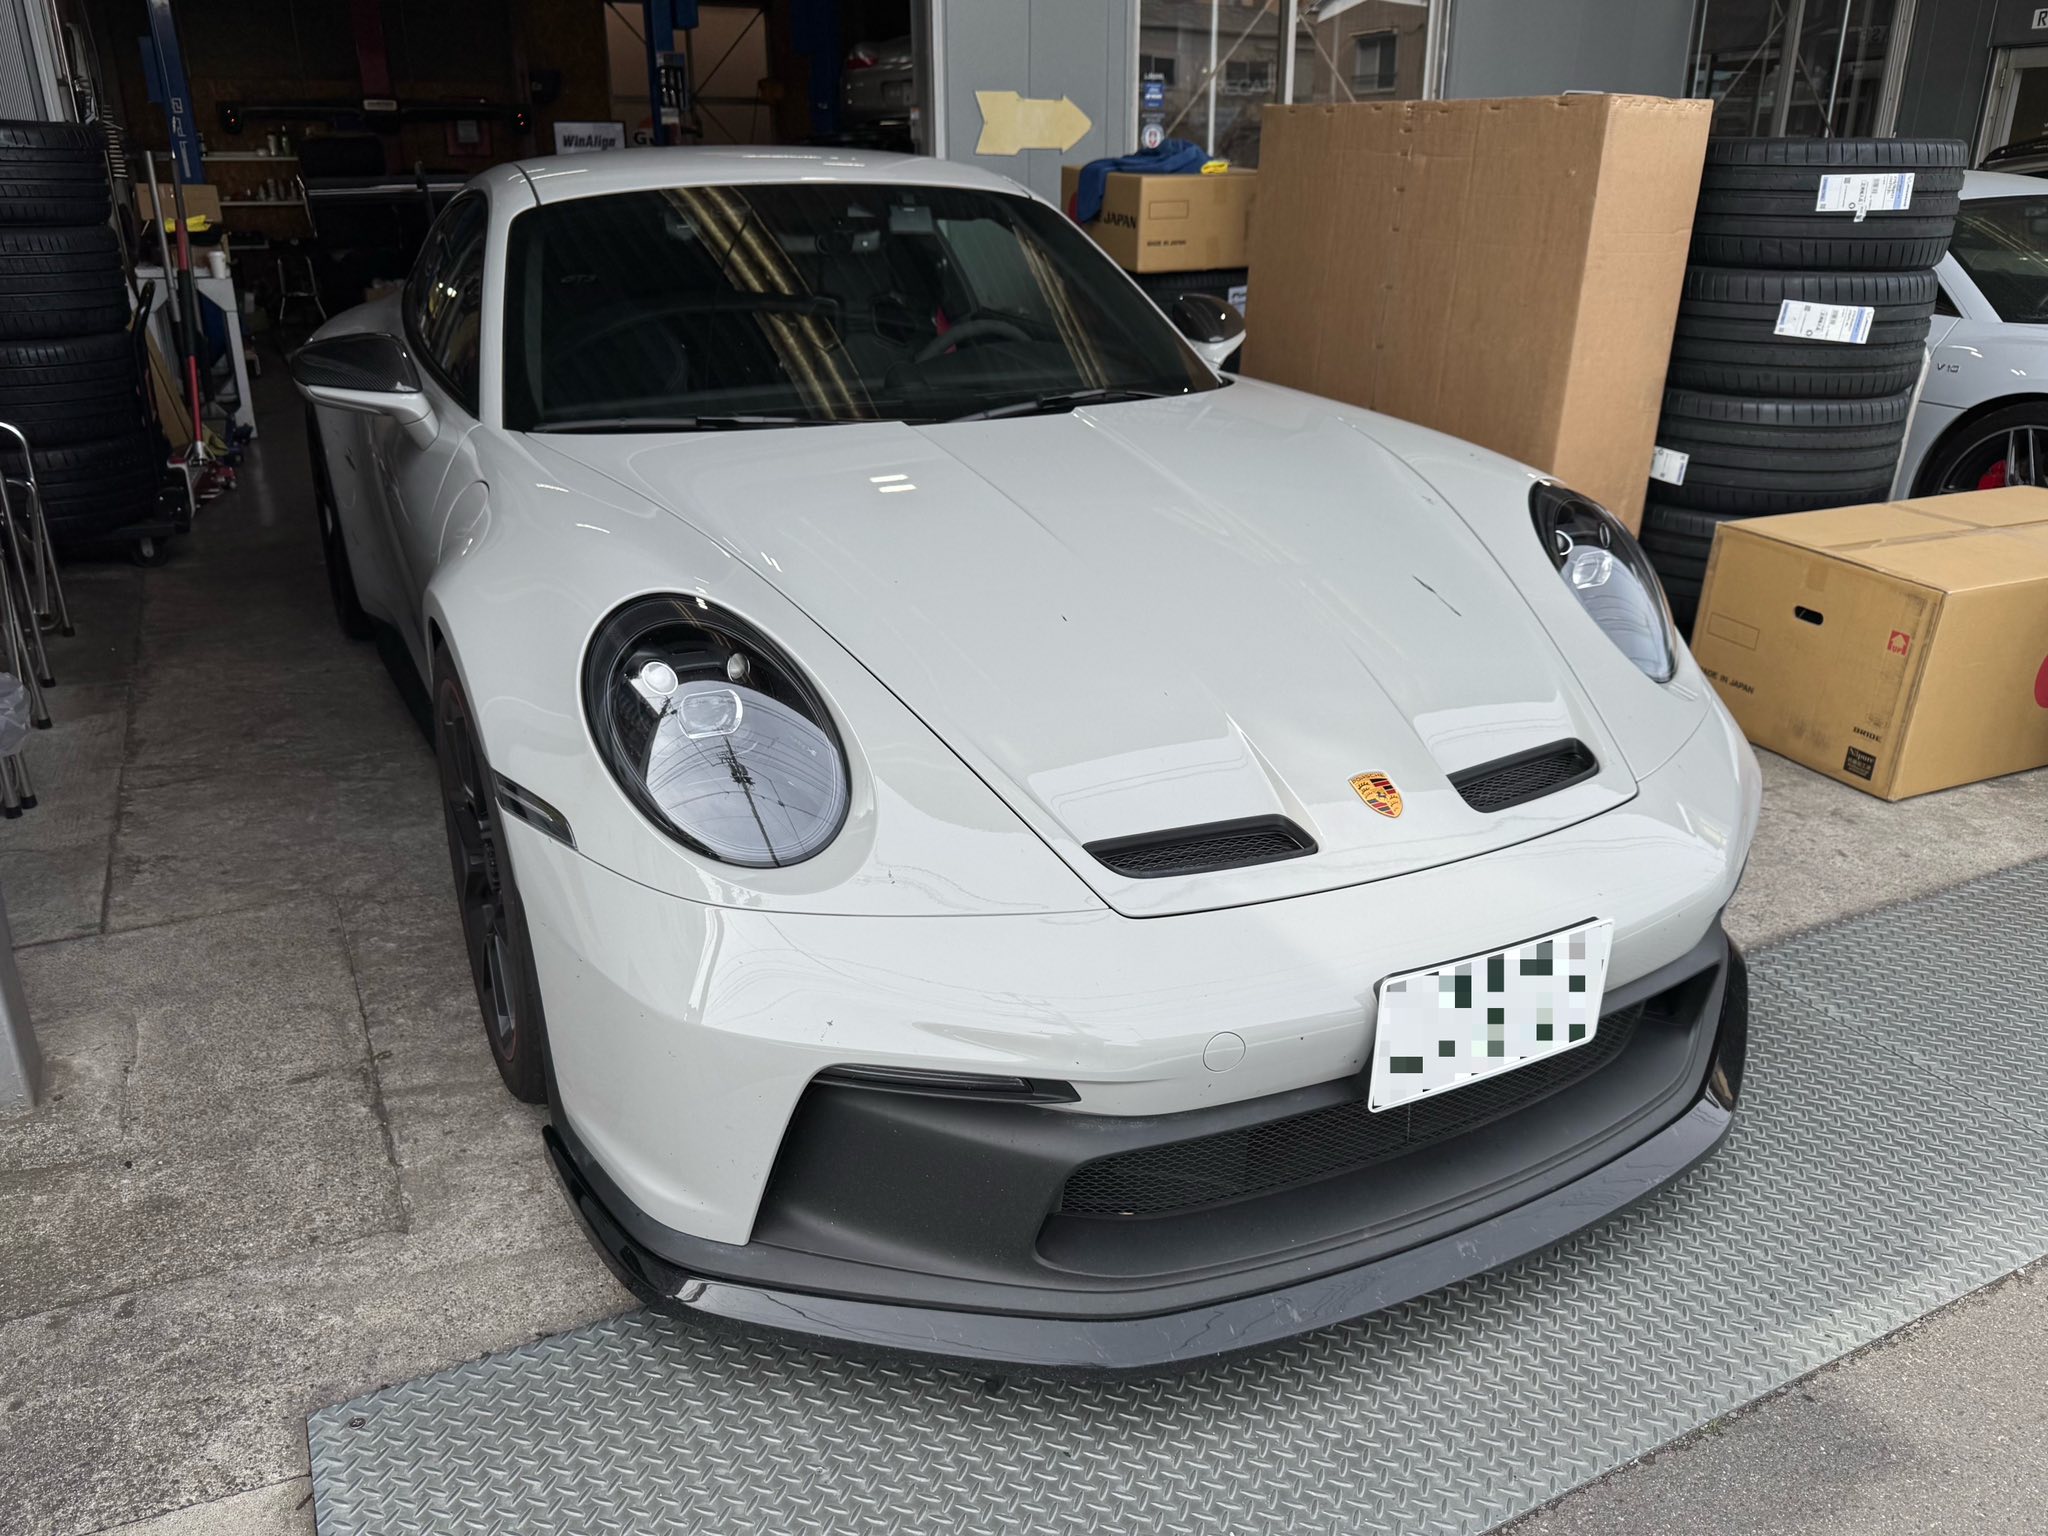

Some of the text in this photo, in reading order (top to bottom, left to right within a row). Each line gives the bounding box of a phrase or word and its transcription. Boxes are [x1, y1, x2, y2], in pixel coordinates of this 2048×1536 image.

[563, 134, 616, 151] WinAlign
[1104, 211, 1137, 229] JAPAN
[1937, 362, 1960, 373] V10
[1720, 674, 1728, 684] IN
[1729, 678, 1754, 695] JAPAN
